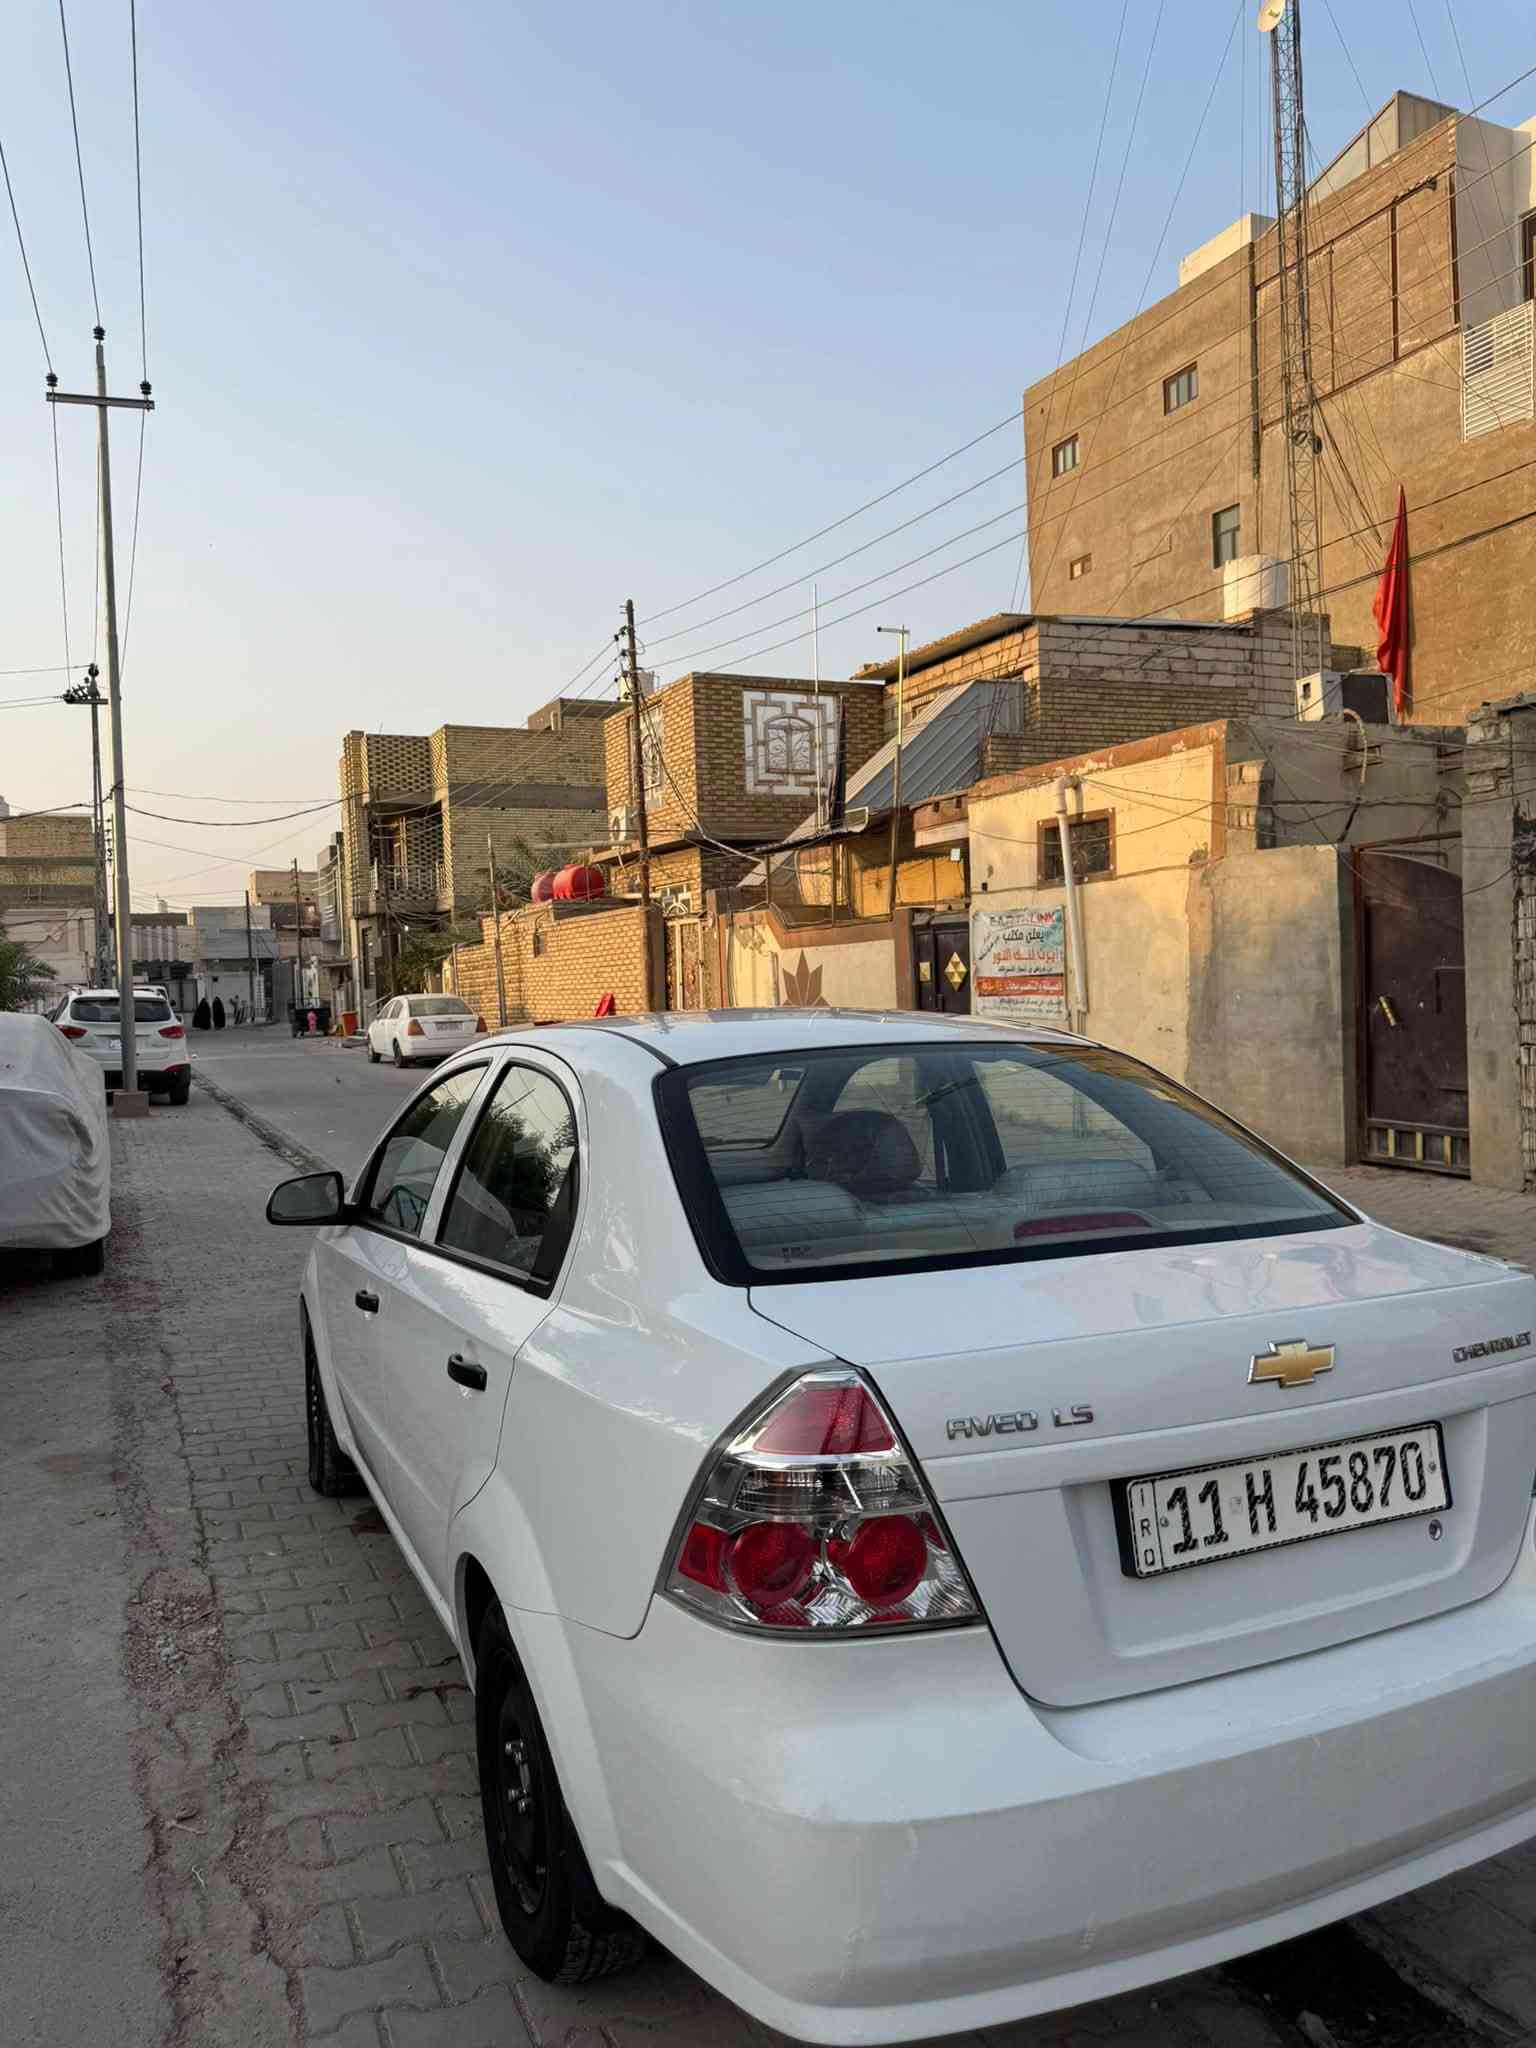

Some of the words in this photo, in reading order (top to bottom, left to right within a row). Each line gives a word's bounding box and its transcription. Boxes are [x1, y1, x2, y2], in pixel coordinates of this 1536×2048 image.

[1452, 1330, 1531, 1363] CHEVROLET
[946, 1409, 1039, 1440] AVEO
[1051, 1403, 1094, 1428] LS
[1166, 1480, 1229, 1555] 11
[1245, 1469, 1277, 1536] H
[1294, 1441, 1427, 1524] 45870
